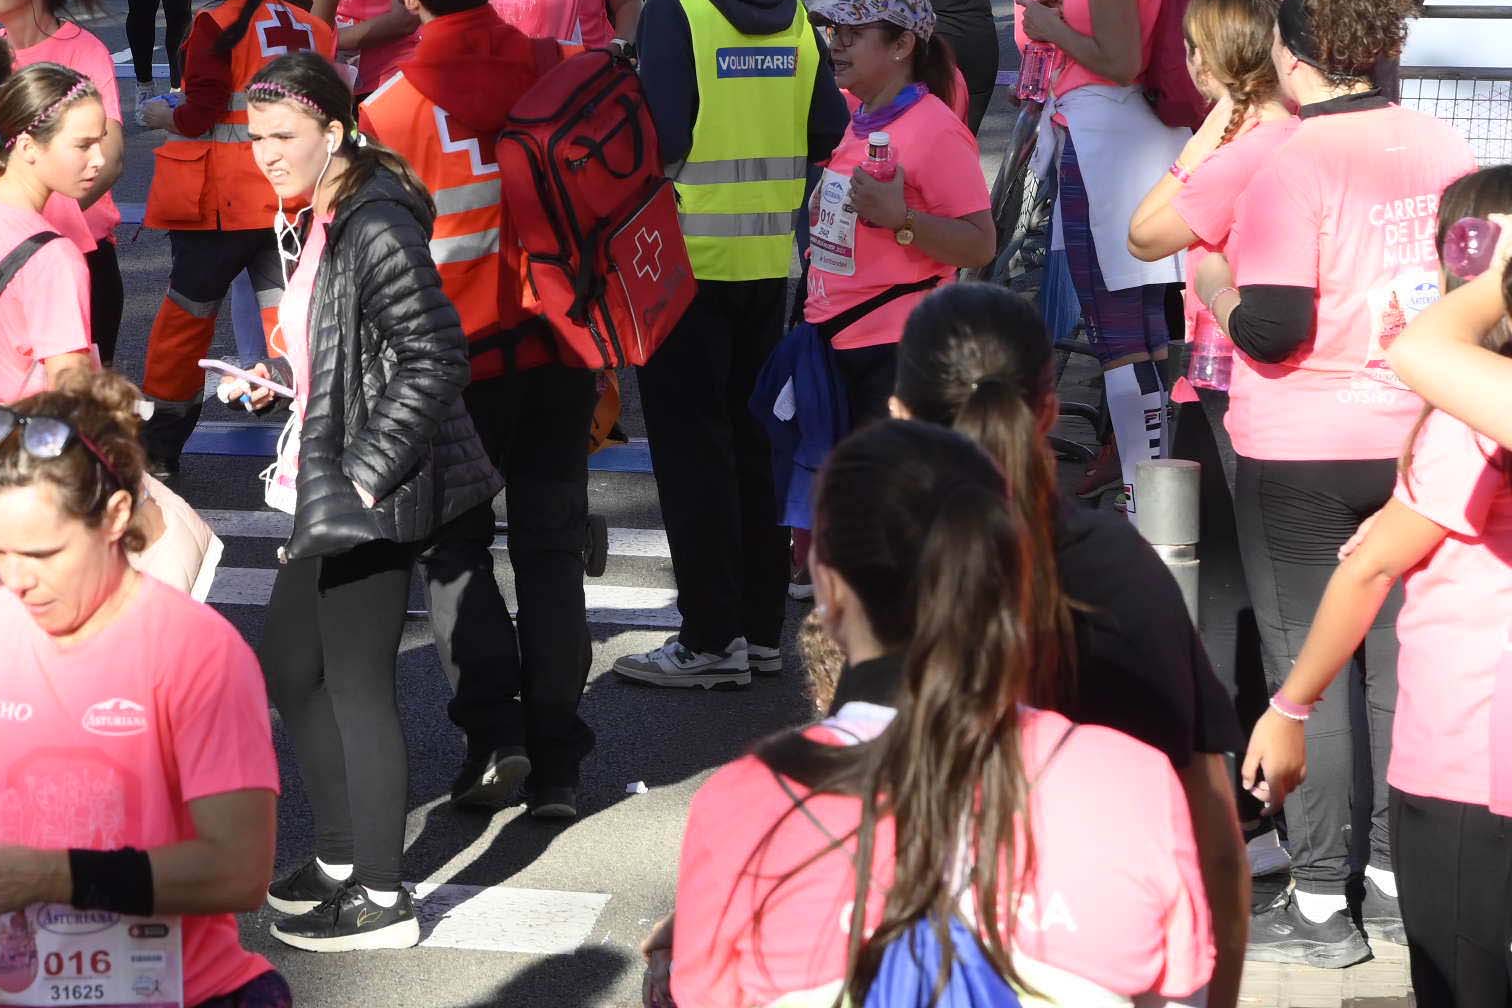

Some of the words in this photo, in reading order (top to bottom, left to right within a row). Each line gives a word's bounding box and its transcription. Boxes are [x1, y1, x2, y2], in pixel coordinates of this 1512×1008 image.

[718, 53, 796, 74] VOLUNTARIS
[1369, 193, 1437, 226] CARRER
[1384, 223, 1409, 243] DE
[1384, 241, 1439, 269] MUJE
[44, 908, 116, 925] ASTURIANA
[44, 949, 112, 977] 016
[50, 984, 105, 1001] 31625
